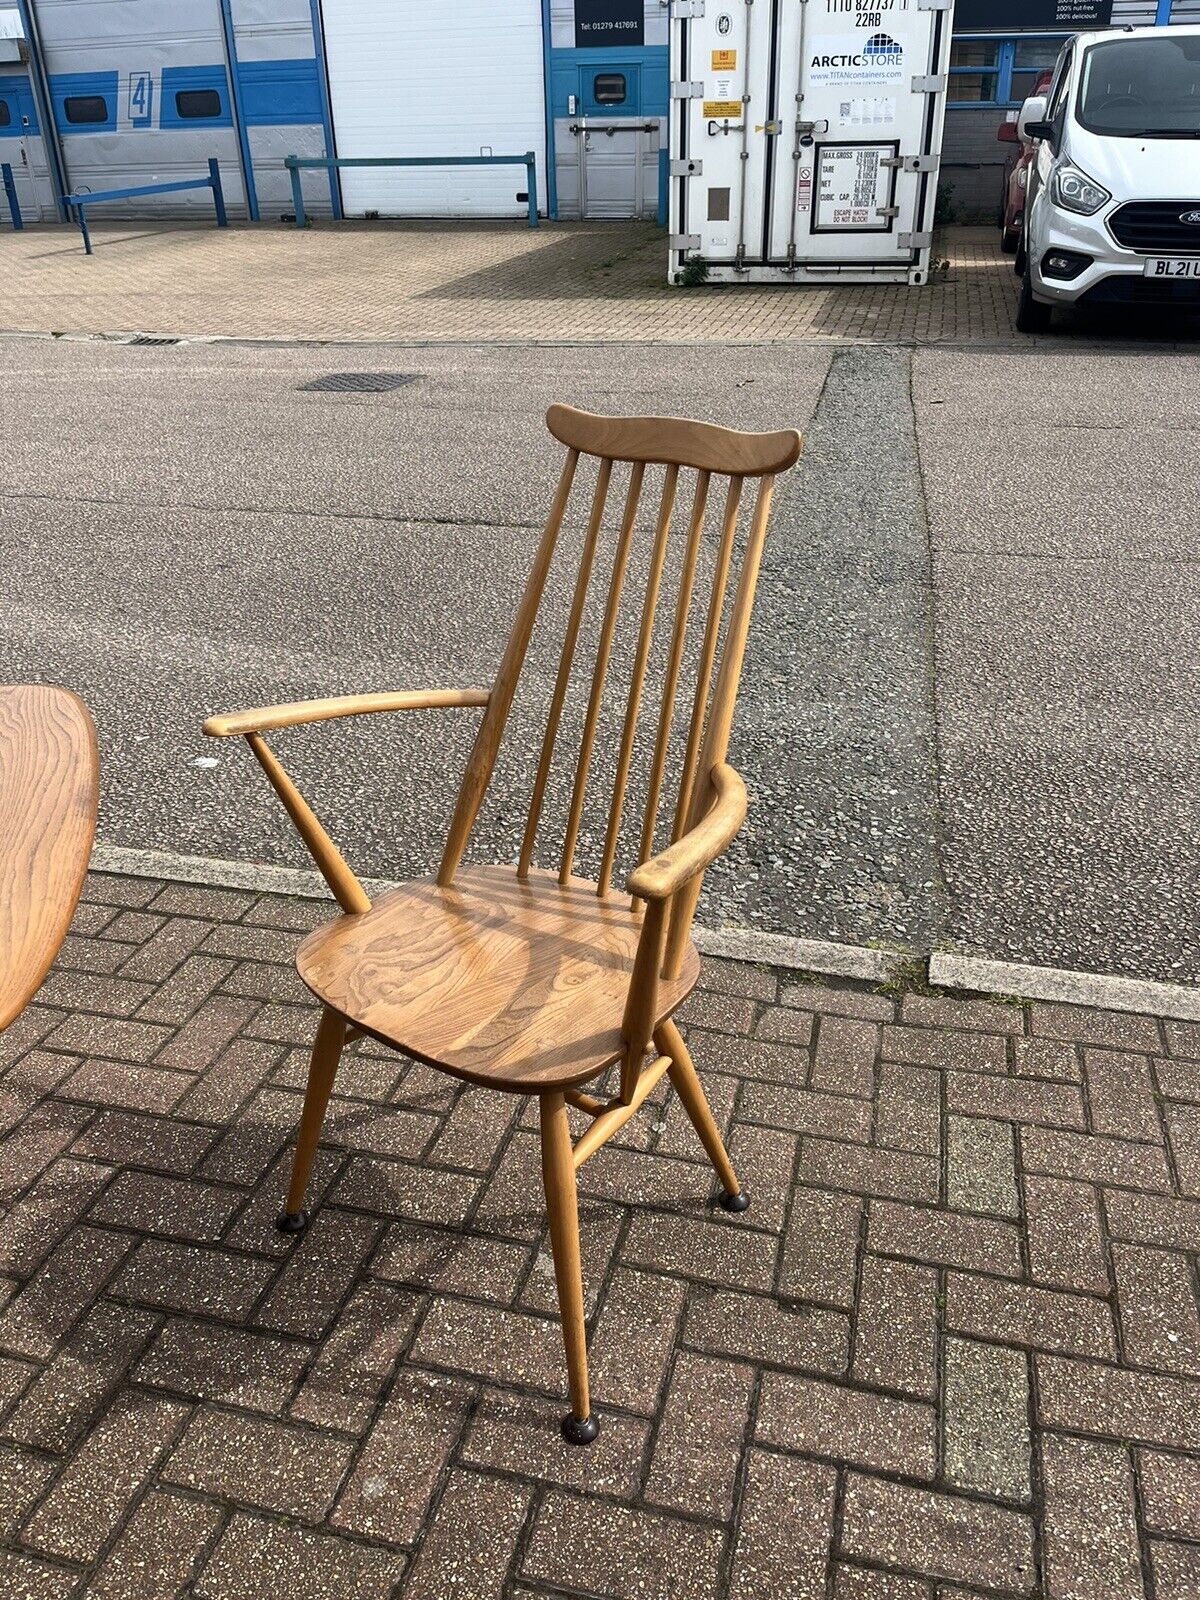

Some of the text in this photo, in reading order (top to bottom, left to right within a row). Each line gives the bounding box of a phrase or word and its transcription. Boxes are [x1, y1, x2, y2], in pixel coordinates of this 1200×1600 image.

[856, 13, 881, 27] 22RB
[811, 54, 903, 67] ARCTICSTORE
[810, 71, 902, 80] www.TITANcontainers.com
[132, 77, 145, 114] 4
[1154, 261, 1190, 276] BL21
